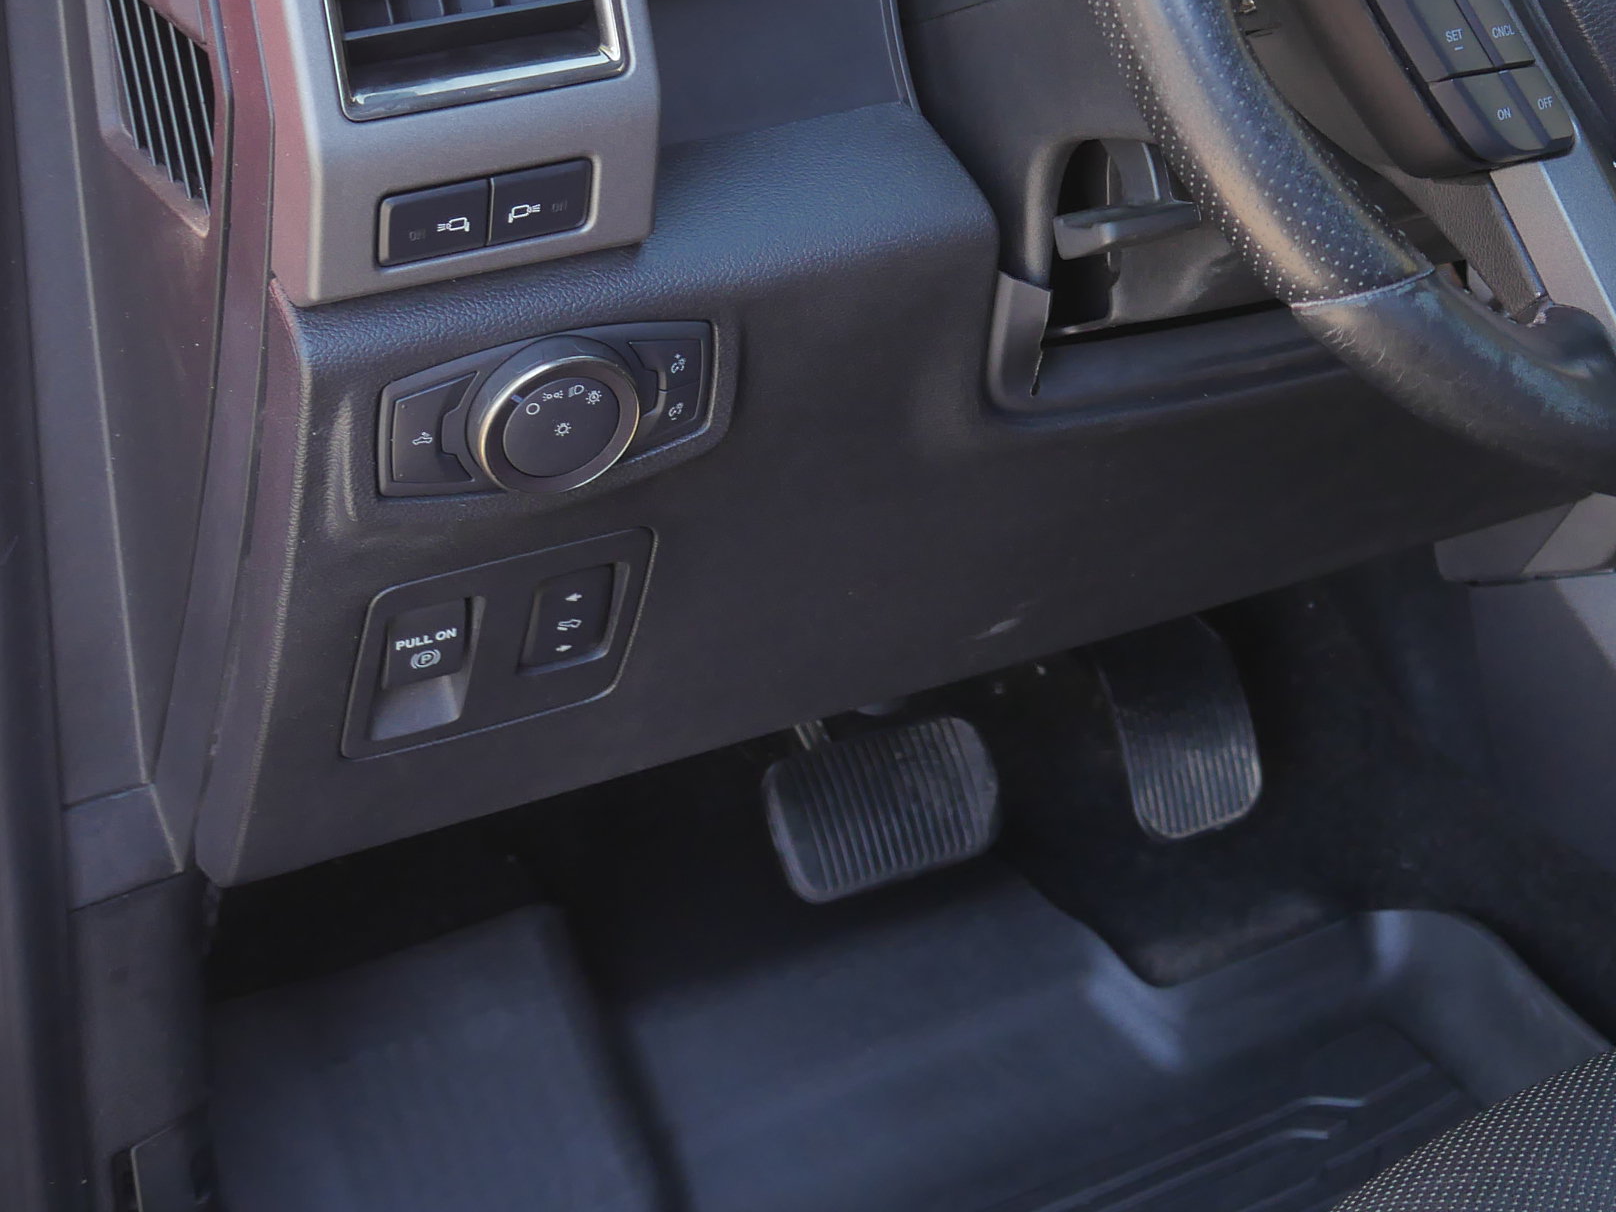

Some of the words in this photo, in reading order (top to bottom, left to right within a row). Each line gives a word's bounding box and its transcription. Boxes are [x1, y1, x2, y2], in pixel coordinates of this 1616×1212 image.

[1445, 29, 1464, 43] SET
[1491, 25, 1516, 39] CNCL
[1537, 96, 1554, 111] OFF
[1497, 107, 1512, 122] ON
[395, 634, 434, 651] PULL
[435, 627, 458, 642] ON
